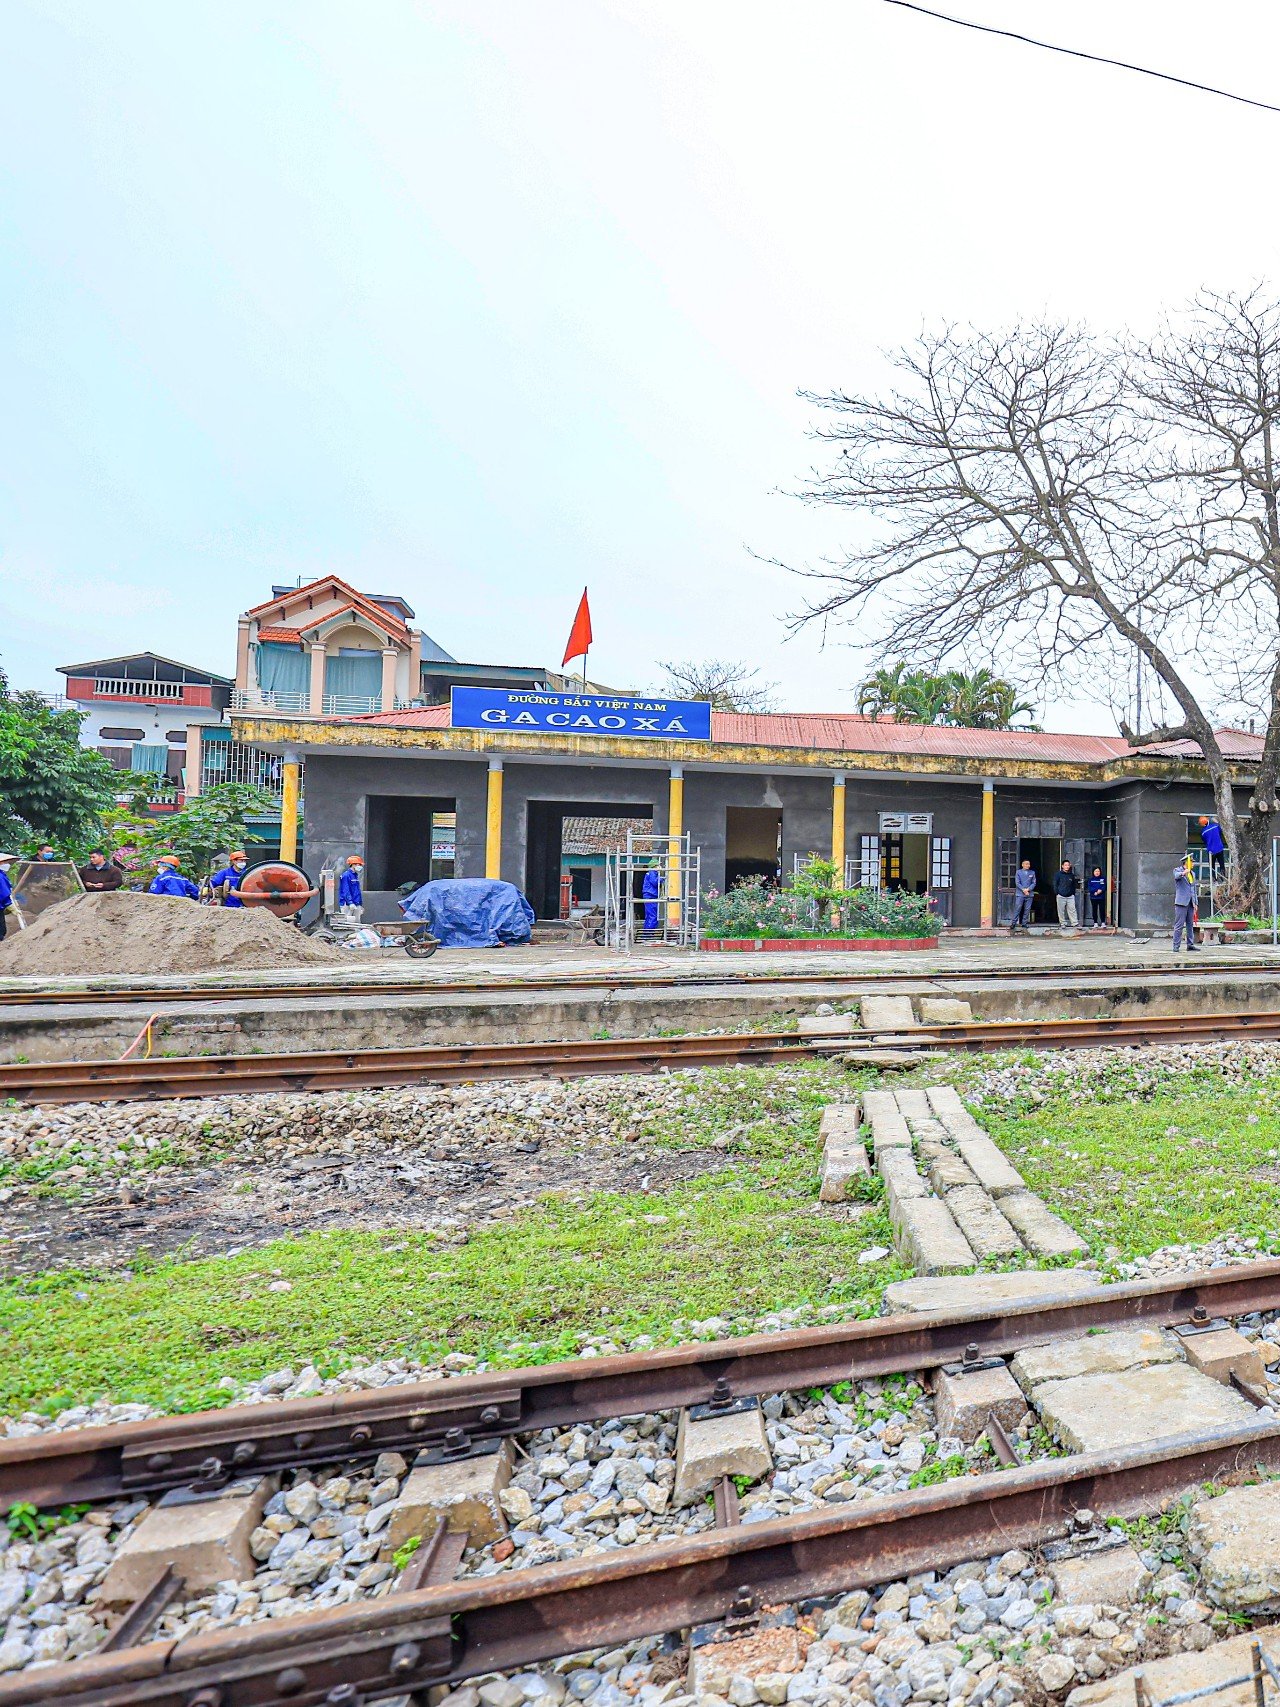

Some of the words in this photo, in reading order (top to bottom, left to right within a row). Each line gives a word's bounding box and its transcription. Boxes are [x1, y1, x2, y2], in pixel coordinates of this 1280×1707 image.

[507, 694, 559, 705] ĐƯỜNG
[564, 696, 592, 707] SẮT
[595, 699, 629, 711] VIỆT
[633, 702, 667, 712] NAM
[480, 709, 540, 725] GA
[546, 713, 626, 729] CAO
[631, 715, 689, 733] XÁ
